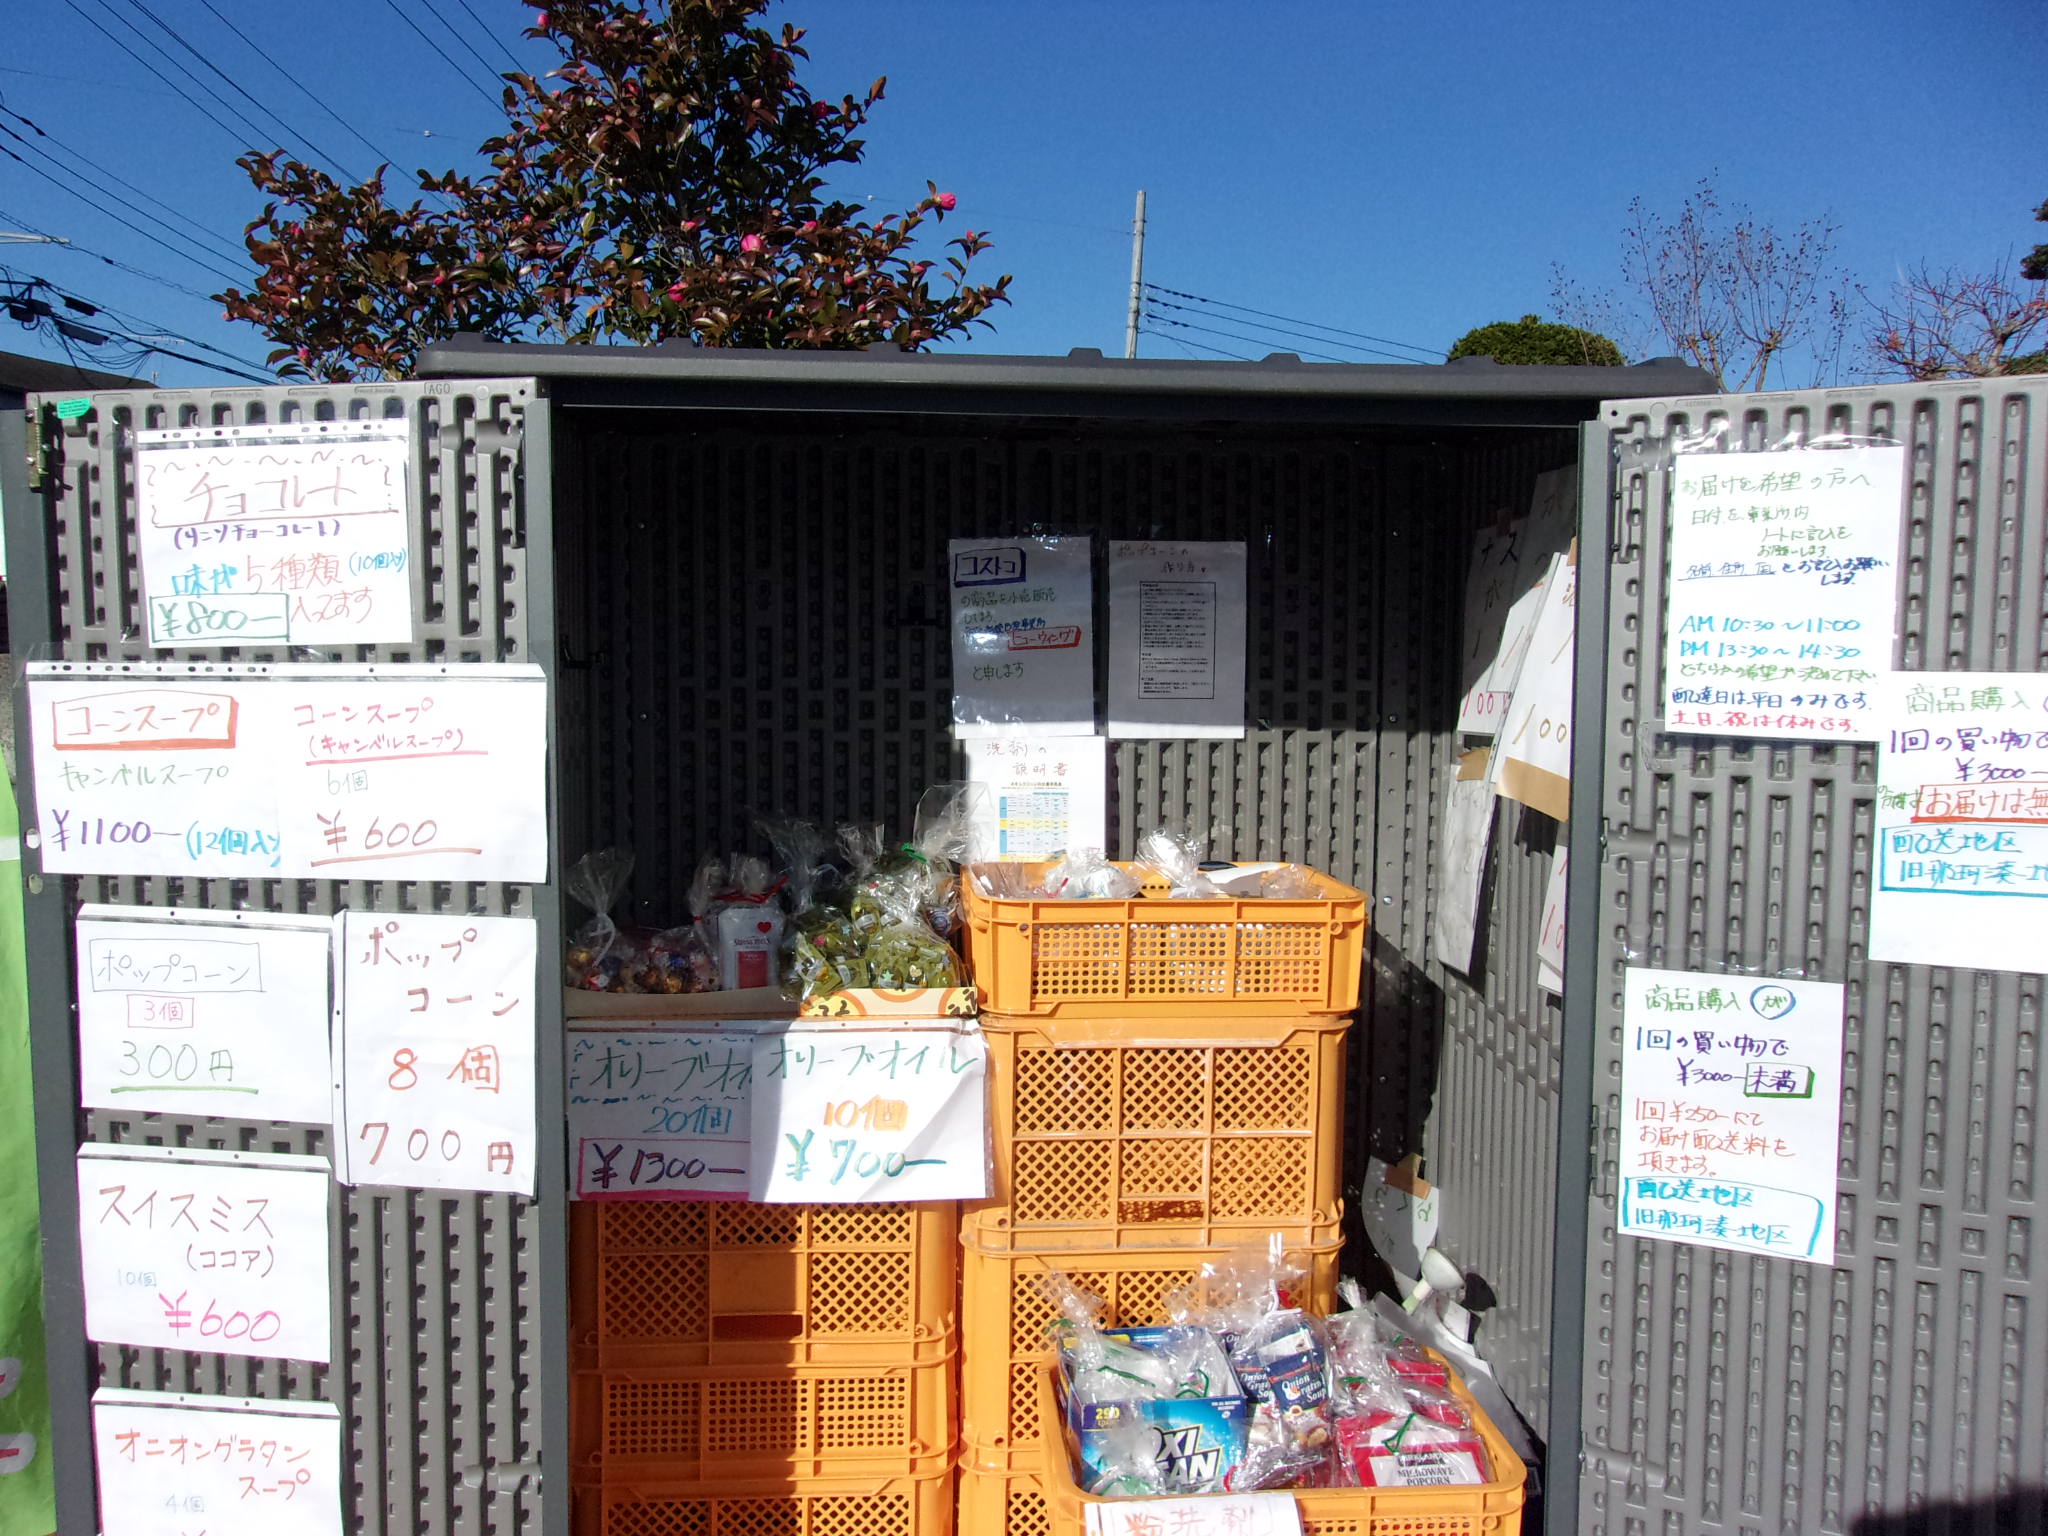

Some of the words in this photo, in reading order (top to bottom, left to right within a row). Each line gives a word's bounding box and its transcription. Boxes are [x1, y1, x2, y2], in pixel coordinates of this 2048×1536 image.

[960, 556, 1016, 576] コストコ
[1679, 615, 1715, 633] AM
[1680, 640, 1709, 656] PM
[67, 702, 220, 736] コーンスープ
[294, 697, 434, 727] コーンスープ
[309, 728, 464, 758] (キャンベルスープ)
[58, 761, 230, 792] キャンベルスープ
[327, 769, 369, 795] 6個
[316, 808, 438, 854] ¥600
[1892, 828, 2023, 855] 配送地区
[360, 921, 478, 968] ポップ
[98, 949, 250, 985] ポップコーン
[143, 1000, 183, 1021] 3個
[407, 987, 520, 1016] コーン
[119, 1040, 234, 1082] 300円
[388, 1044, 500, 1094] 8個
[767, 1038, 979, 1080] オリーブオイル
[642, 1104, 732, 1135] 20個
[822, 1094, 909, 1131] 10個
[360, 1121, 514, 1175] 700円
[98, 1184, 274, 1239] スイスミス
[186, 1243, 274, 1279] (ココア)
[158, 1289, 281, 1342] ¥600
[115, 1427, 312, 1468] オニオングラタン
[238, 1467, 312, 1501] スープ
